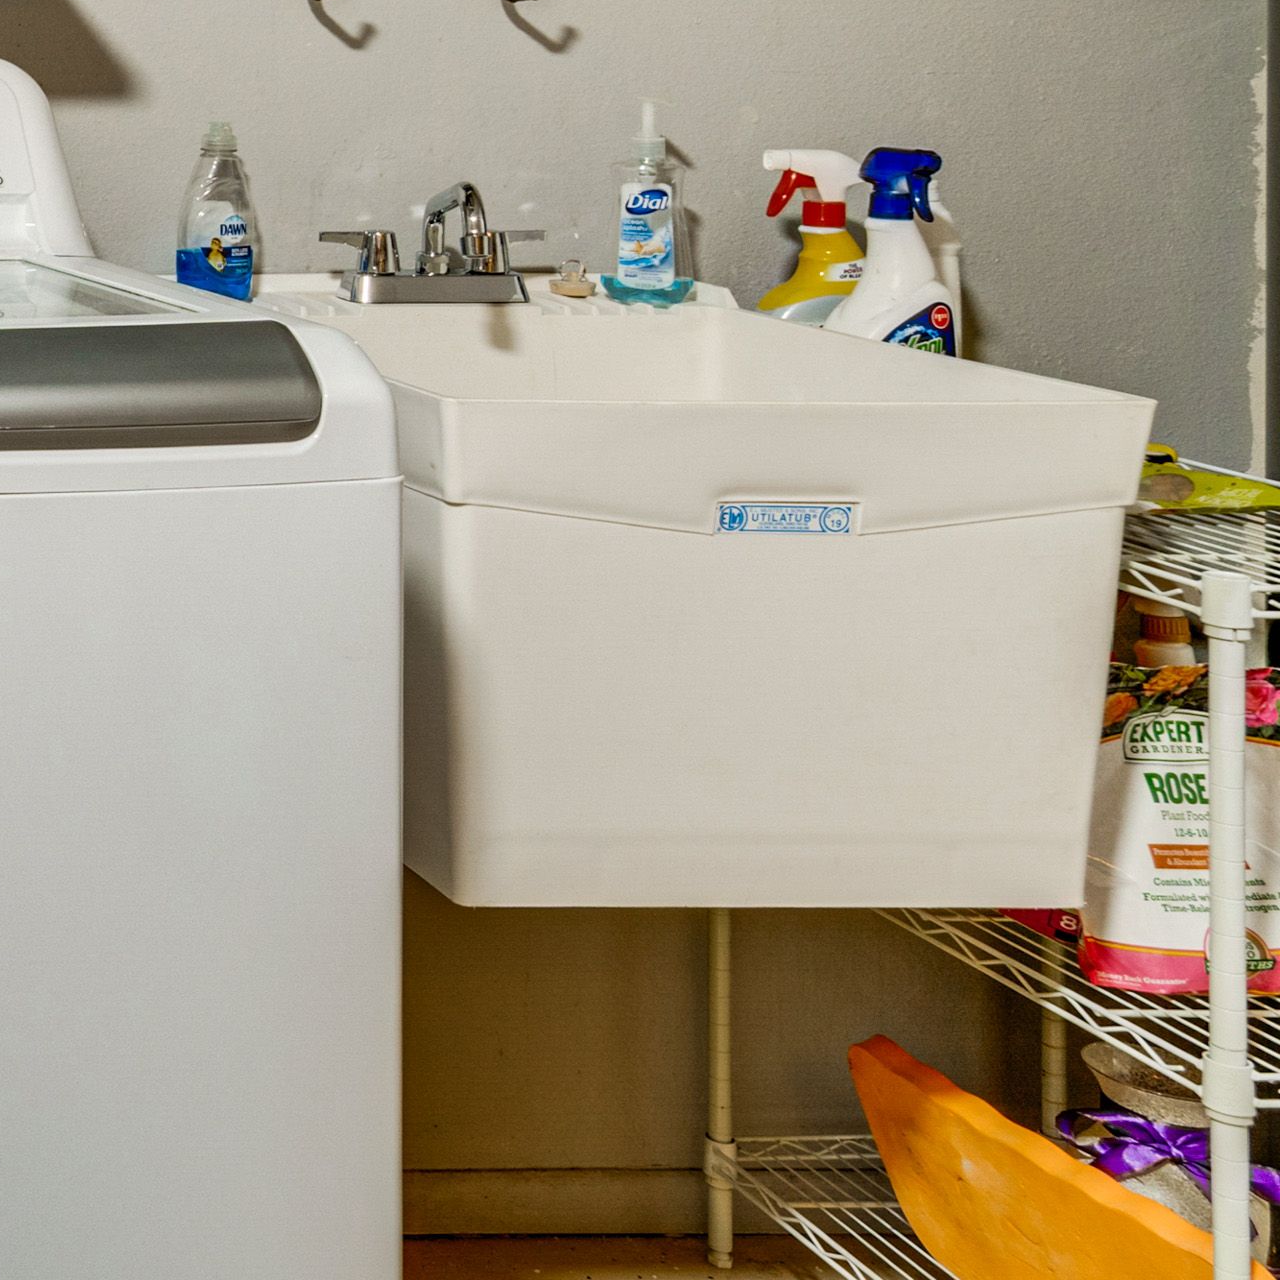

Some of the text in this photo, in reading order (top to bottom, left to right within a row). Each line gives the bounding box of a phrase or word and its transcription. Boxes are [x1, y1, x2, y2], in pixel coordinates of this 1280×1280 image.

[627, 194, 668, 210] Dial
[220, 223, 247, 236] DAWN
[831, 520, 842, 528] 19
[1129, 721, 1205, 743] EXPERT
[1143, 772, 1210, 805] ROSE
[1160, 810, 1210, 821] Plant Food
[1153, 878, 1192, 886] Contains
[1142, 892, 1196, 901] Formulated
[1161, 904, 1210, 912] Time-Rele
